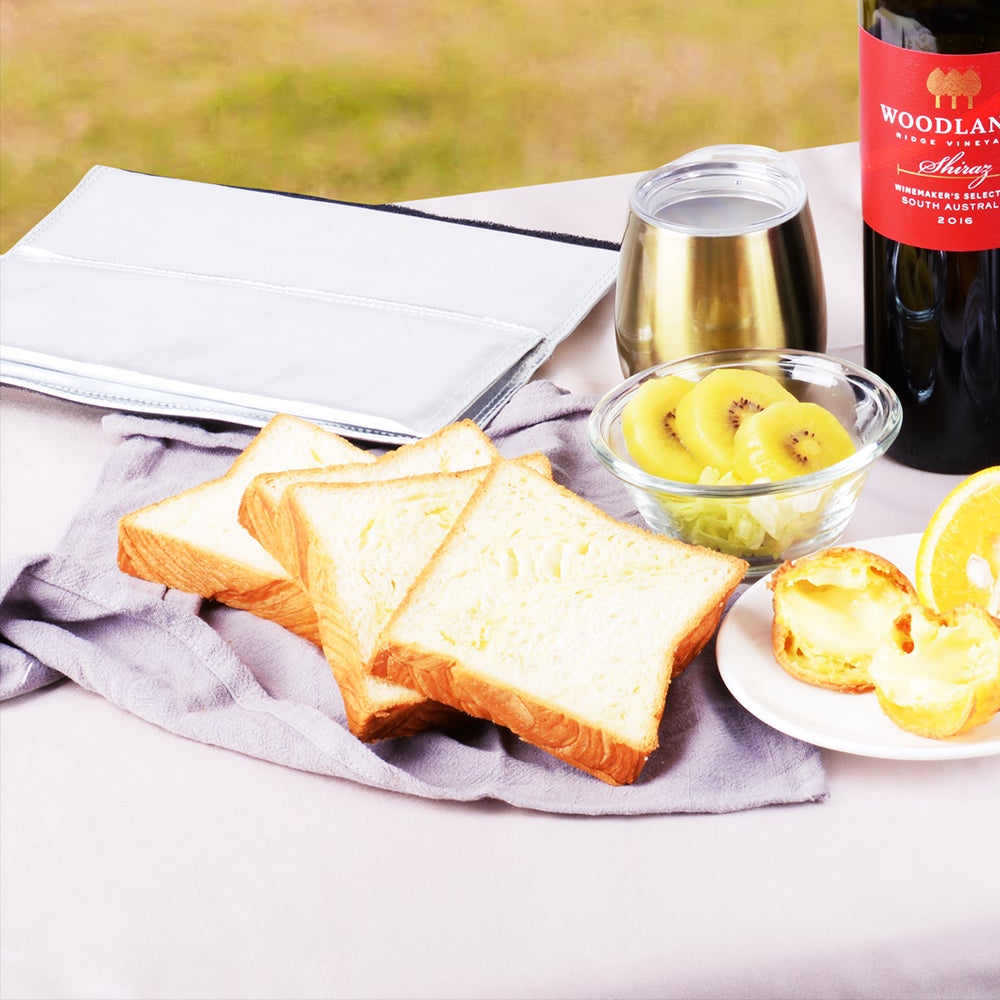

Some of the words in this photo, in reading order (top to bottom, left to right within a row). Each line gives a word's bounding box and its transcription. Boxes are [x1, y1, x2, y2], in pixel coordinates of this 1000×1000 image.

[896, 132, 936, 146] RIDGE
[918, 151, 993, 189] Shiraz
[895, 183, 960, 200] WINEMAKER'S
[901, 196, 940, 210] SOUTH
[937, 216, 973, 225] 2016
